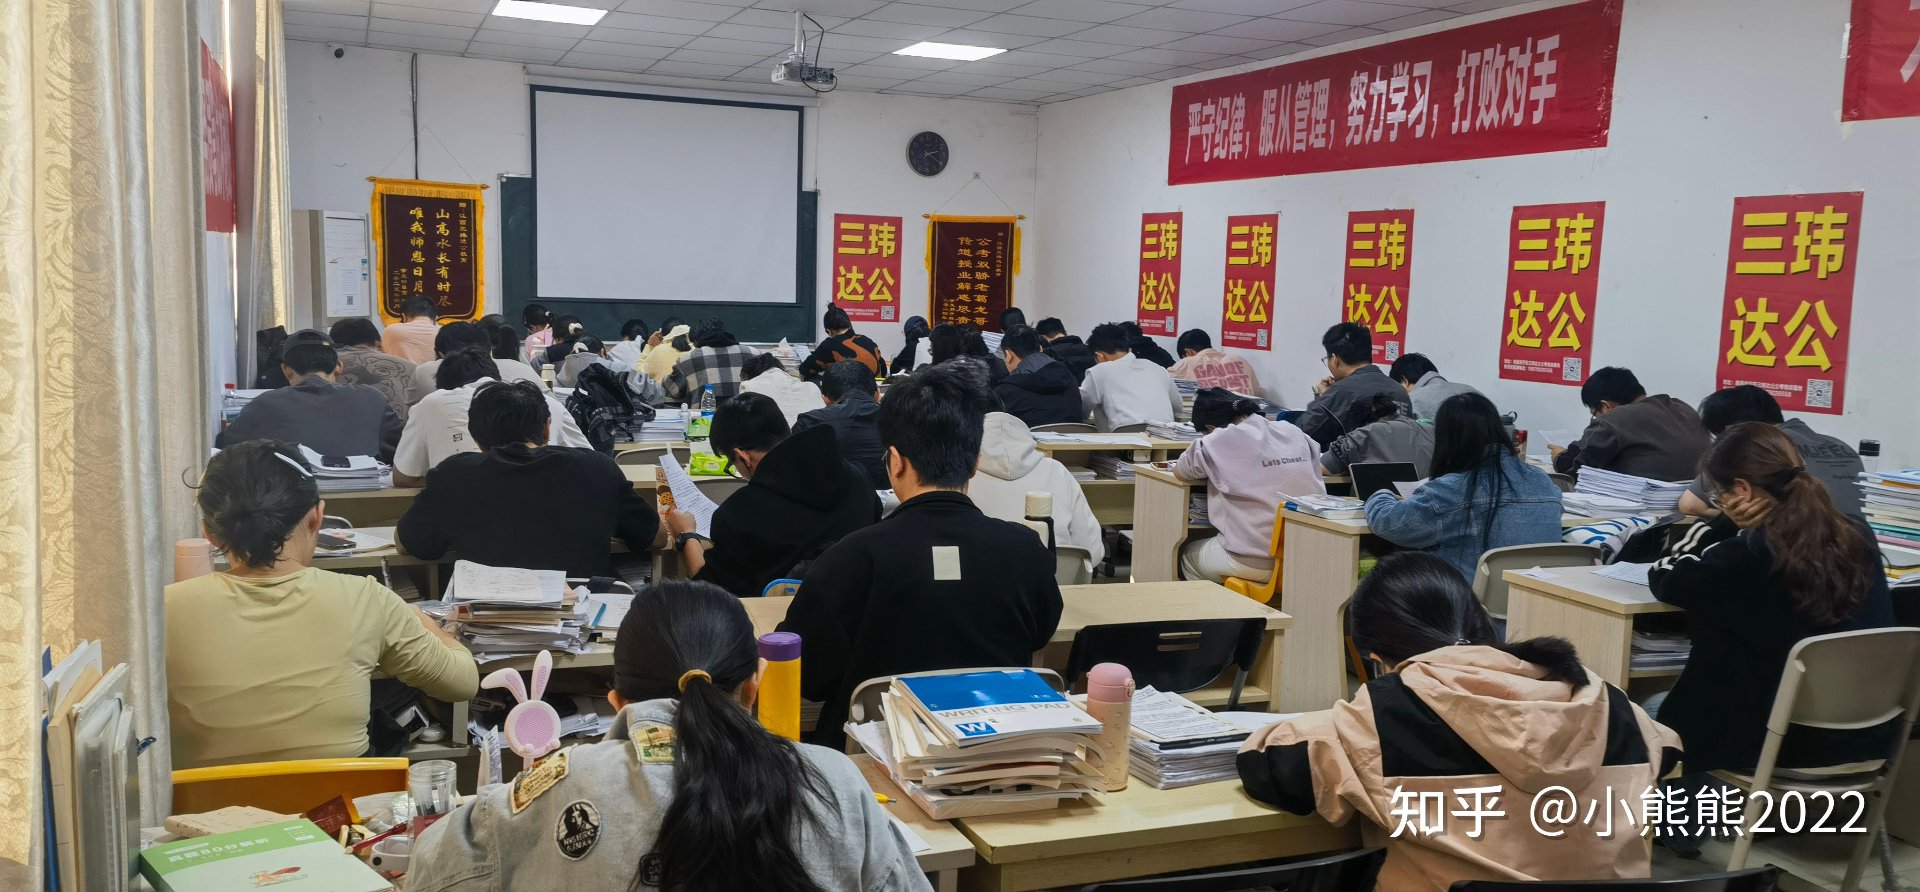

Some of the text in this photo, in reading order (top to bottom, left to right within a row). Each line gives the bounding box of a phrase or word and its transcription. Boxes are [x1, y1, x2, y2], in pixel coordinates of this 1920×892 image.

[409, 206, 426, 296] 唯我师恩日月
[436, 208, 452, 307] 山高水长有时尽
[838, 222, 896, 257] 三玮
[1142, 219, 1178, 261] 三玮
[1229, 222, 1273, 267] 三玮
[1349, 219, 1407, 271] 三玮
[1513, 212, 1595, 275] 三玮
[1735, 205, 1849, 280] 三玮
[837, 265, 895, 302] 达公
[1140, 272, 1175, 312] 达公
[1226, 279, 1270, 325] 达公
[1507, 290, 1586, 352] 达公
[1727, 297, 1839, 372] 达公
[938, 702, 1070, 718] WRITING PAD
